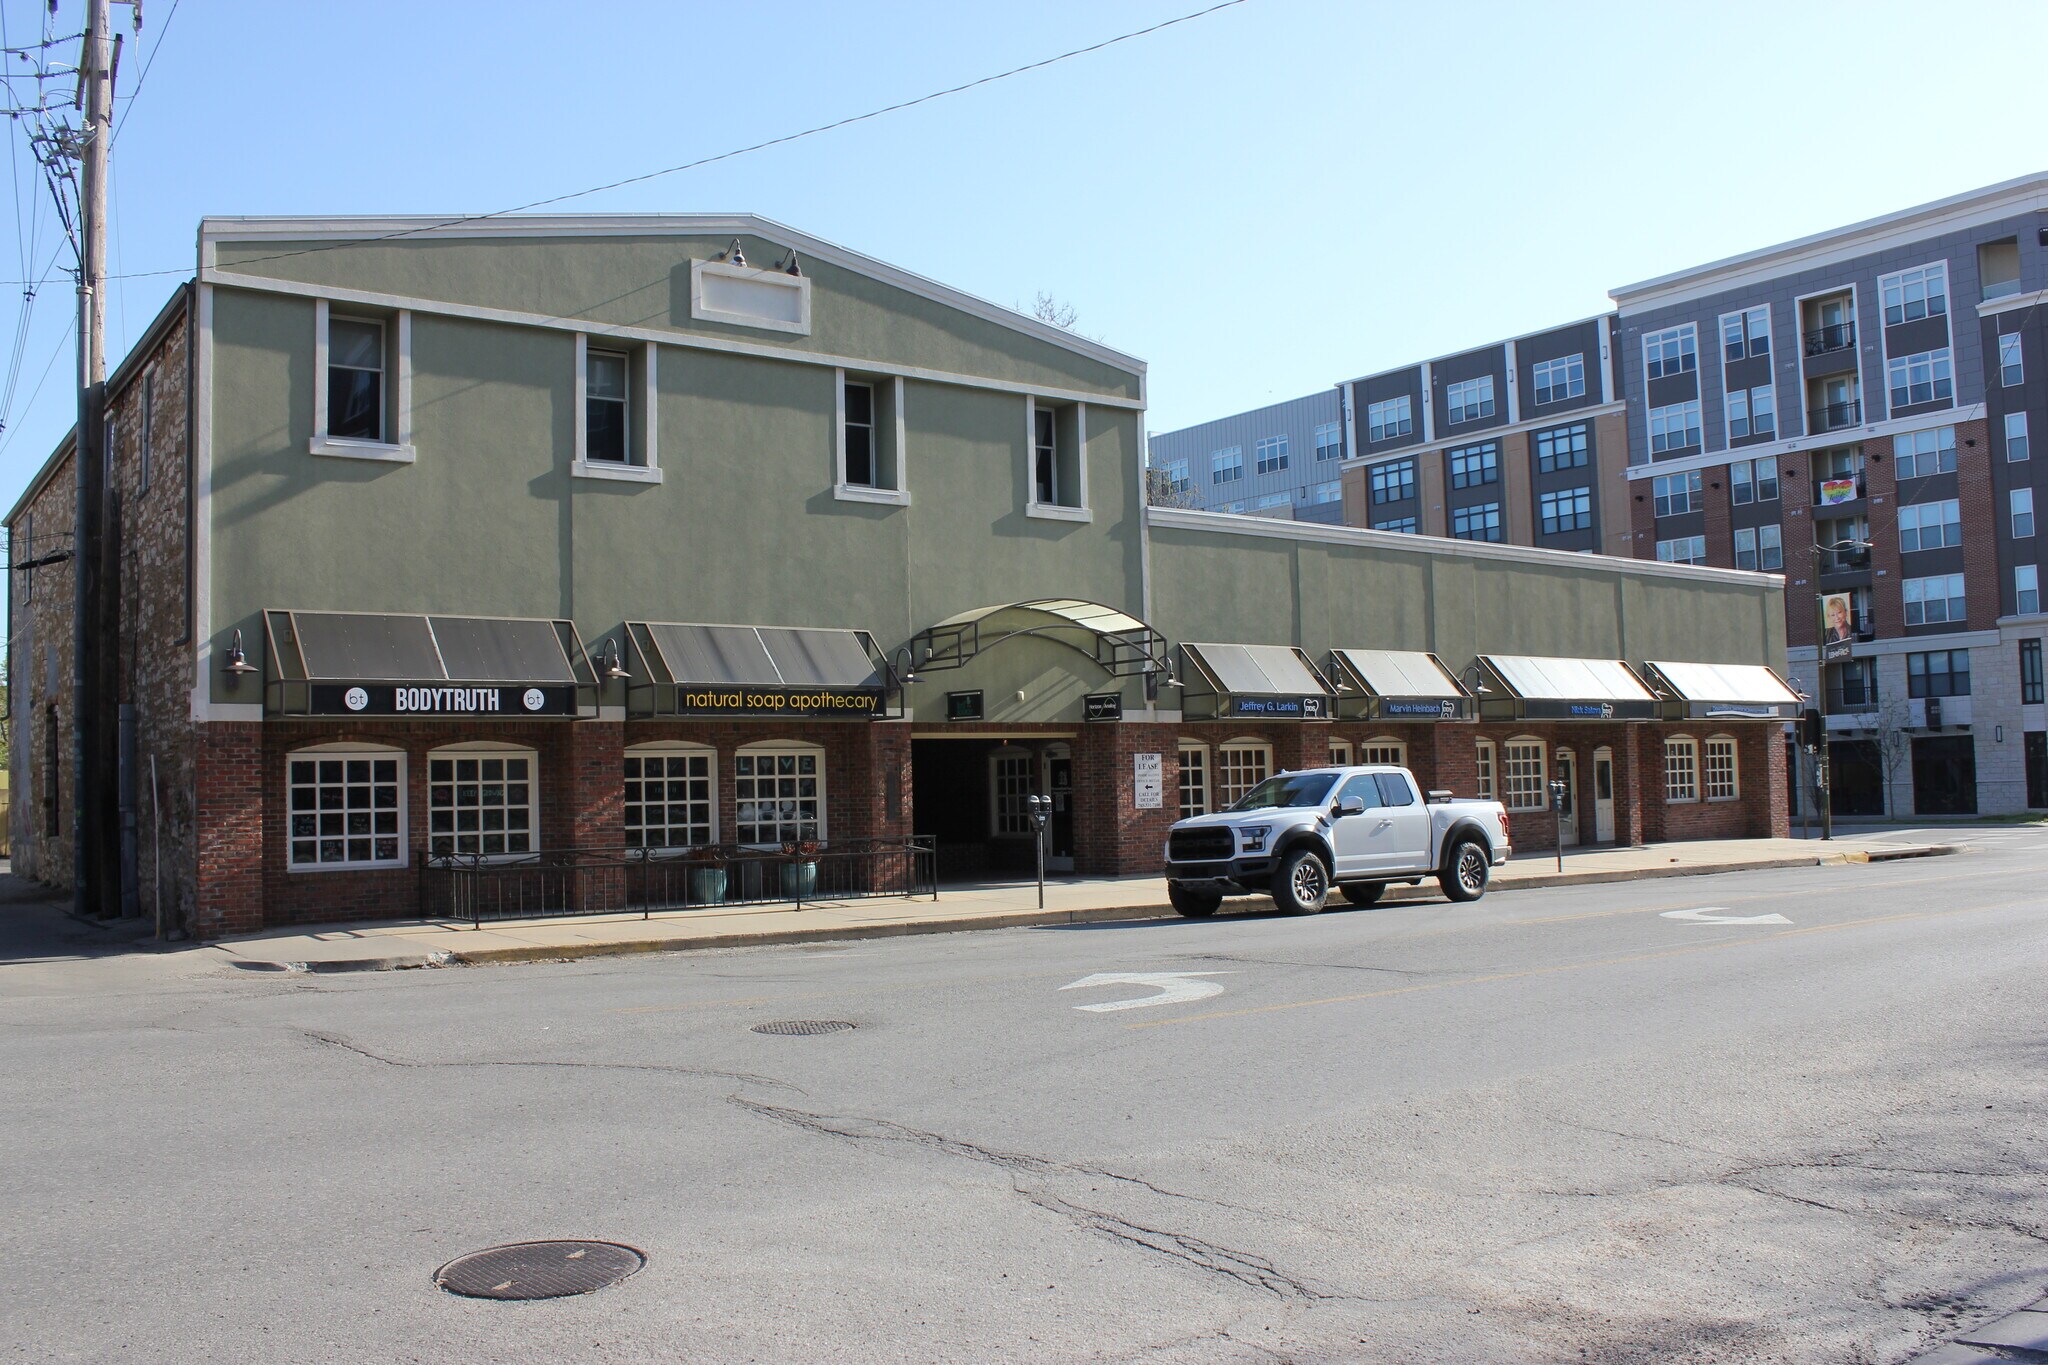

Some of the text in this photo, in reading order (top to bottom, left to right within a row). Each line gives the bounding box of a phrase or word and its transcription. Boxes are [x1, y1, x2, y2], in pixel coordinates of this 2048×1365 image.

[349, 692, 365, 705] bt
[395, 688, 500, 711] BODYTRUTH
[527, 693, 541, 705] bt
[686, 691, 878, 711] natural soap apothecary
[1240, 701, 1299, 713] Jeffrey G. Larkin
[1389, 704, 1412, 713] Marvin
